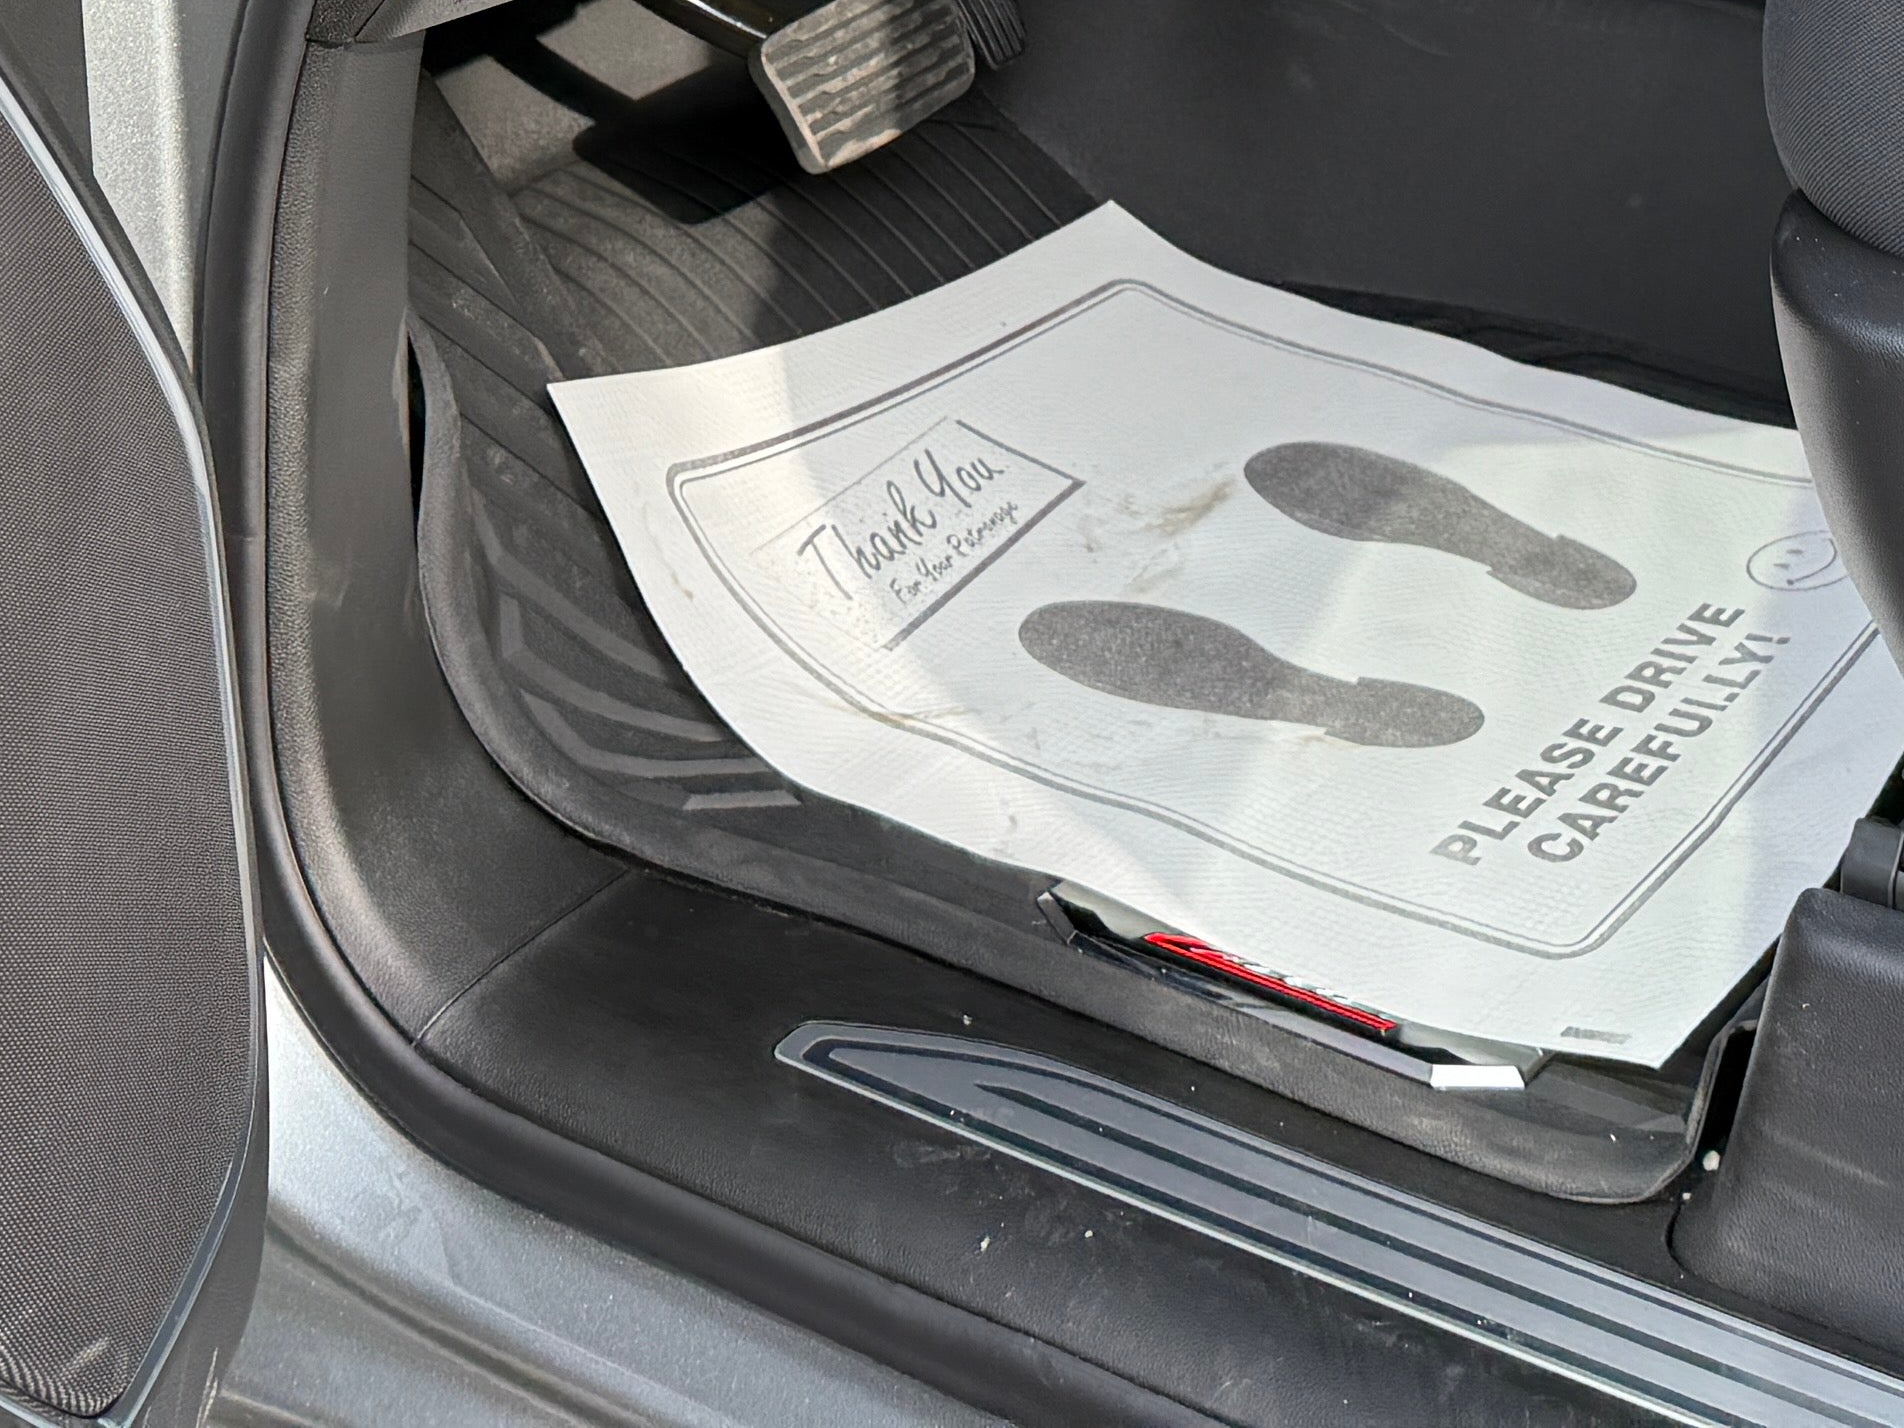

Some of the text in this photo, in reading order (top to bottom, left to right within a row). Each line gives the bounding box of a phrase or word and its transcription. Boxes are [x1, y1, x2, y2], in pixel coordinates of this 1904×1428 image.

[797, 448, 1006, 602] Thank You
[889, 501, 1019, 605] For Your Patronage
[1429, 601, 1746, 867] PLEASE DRIVE
[1526, 632, 1792, 863] CAREFULLY!
